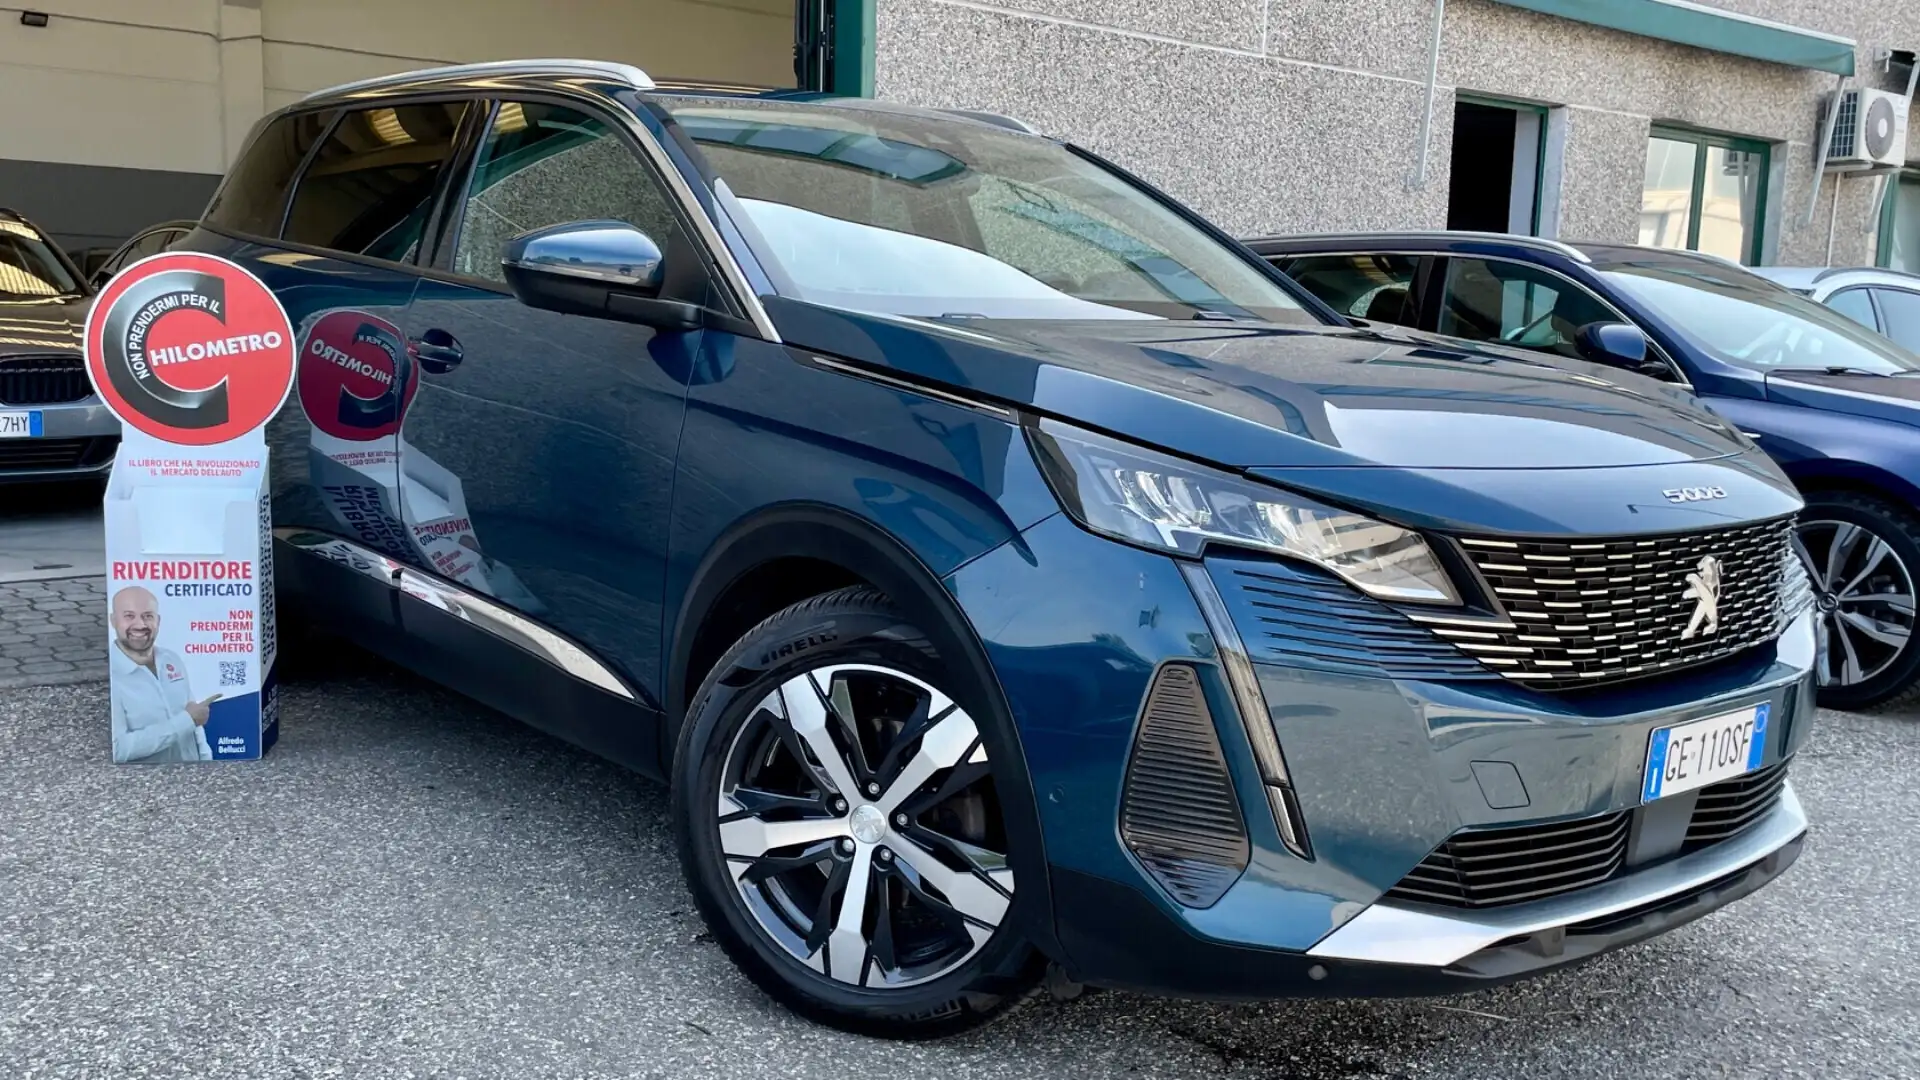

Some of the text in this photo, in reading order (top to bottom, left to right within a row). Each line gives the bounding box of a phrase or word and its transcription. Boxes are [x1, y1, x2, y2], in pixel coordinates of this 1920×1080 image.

[129, 294, 221, 380] NON PRENDERMI PER IL
[149, 331, 283, 367] HILOMETRO
[0, 416, 28, 432] 7HY
[128, 459, 260, 469] IL LIBRO CHE HA RIVOLUZIONATO
[161, 468, 199, 476] MERCATO
[201, 468, 242, 477] DELL'AUTO
[1662, 486, 1728, 504] 5008
[113, 561, 253, 580] RIVENDITORE
[164, 583, 253, 597] CERTIFICATO
[229, 610, 254, 620] NON
[190, 621, 254, 632] PRENDERMI
[222, 632, 254, 642] PER IL
[184, 643, 254, 654] CHILOMETRO
[217, 736, 245, 745] Alfredo
[218, 744, 246, 754] Bellucci
